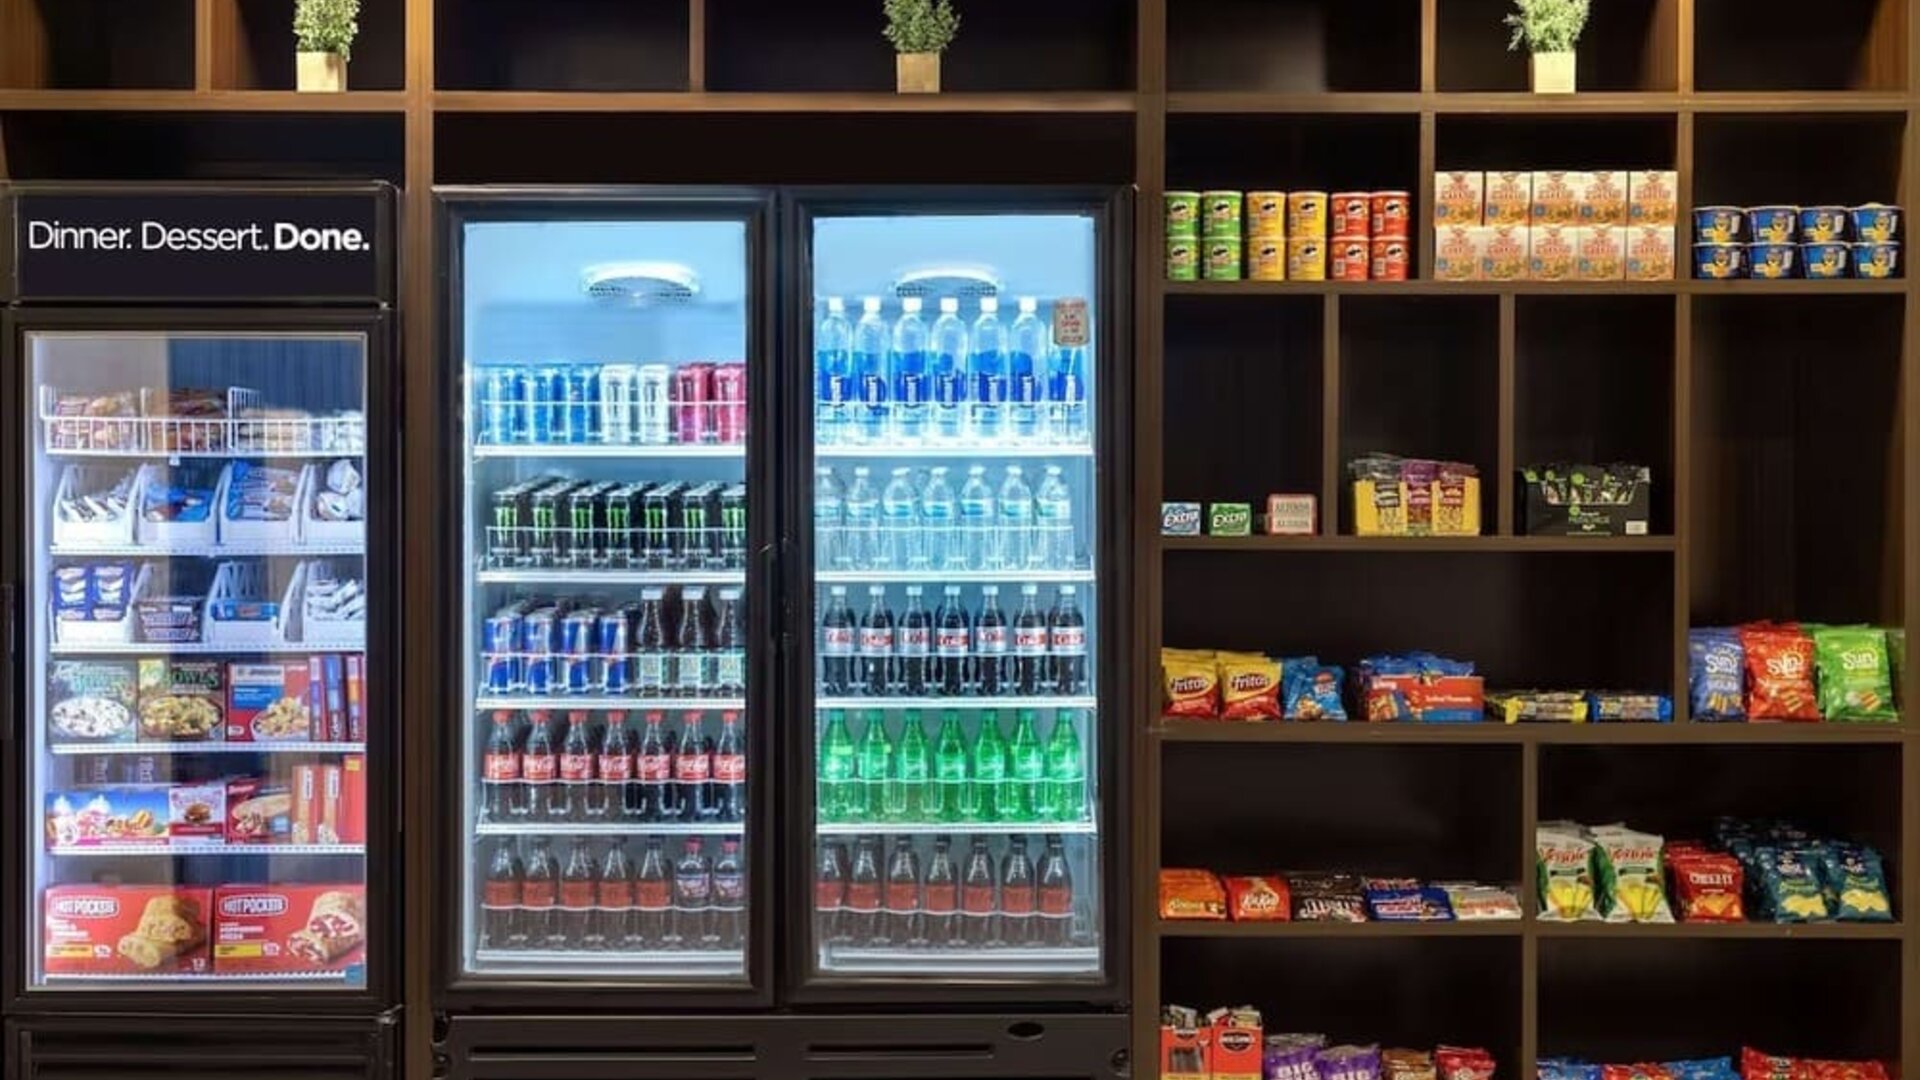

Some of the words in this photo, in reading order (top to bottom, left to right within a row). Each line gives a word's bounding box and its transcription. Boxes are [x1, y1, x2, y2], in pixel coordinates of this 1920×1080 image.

[28, 220, 131, 250] Dinner.
[141, 220, 269, 251] Dessert.
[274, 222, 370, 251] Done.
[1164, 502, 1199, 527] Extra
[1213, 504, 1248, 527] Extra
[1842, 651, 1877, 670] Sun
